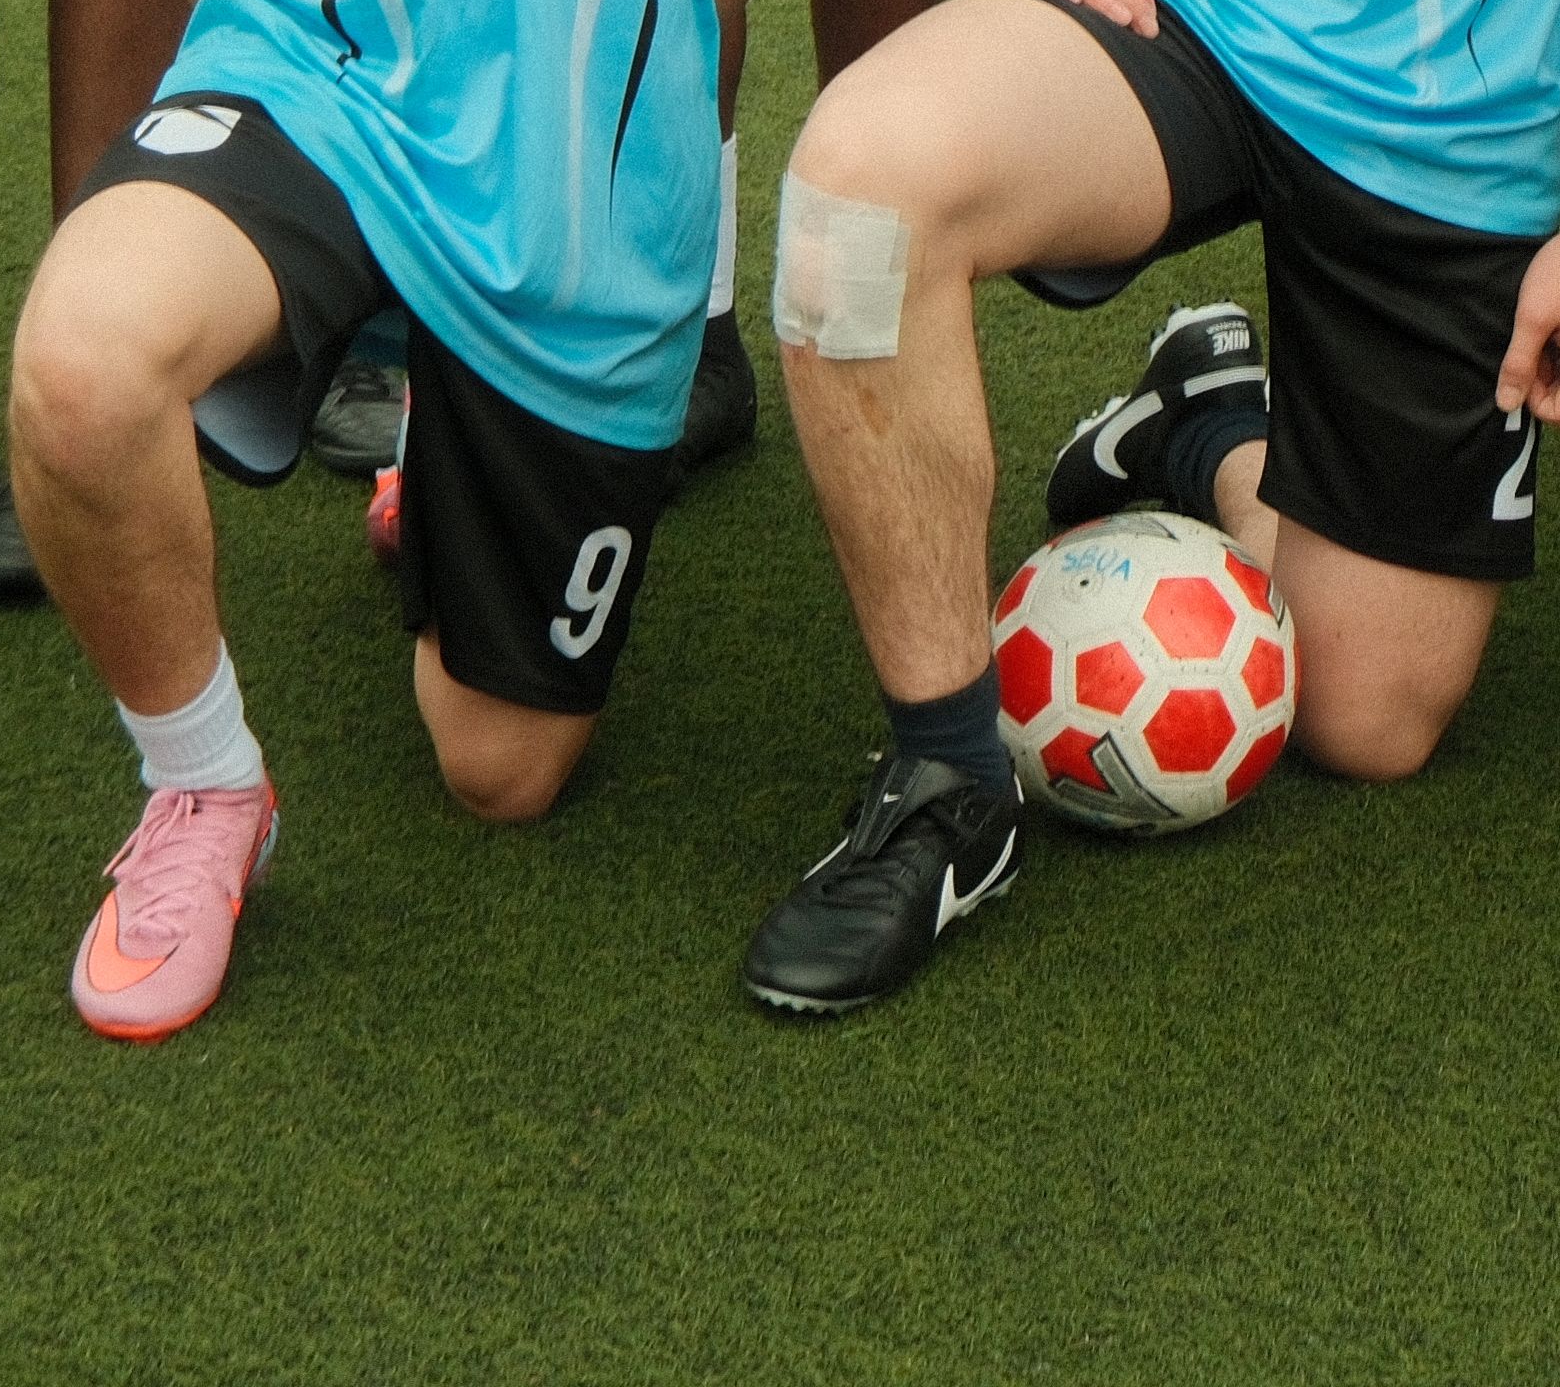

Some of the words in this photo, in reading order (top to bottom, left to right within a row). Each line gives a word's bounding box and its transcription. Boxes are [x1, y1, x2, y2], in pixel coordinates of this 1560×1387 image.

[1211, 329, 1250, 357] NIKE
[1491, 404, 1538, 521] 2
[550, 525, 633, 659] 9
